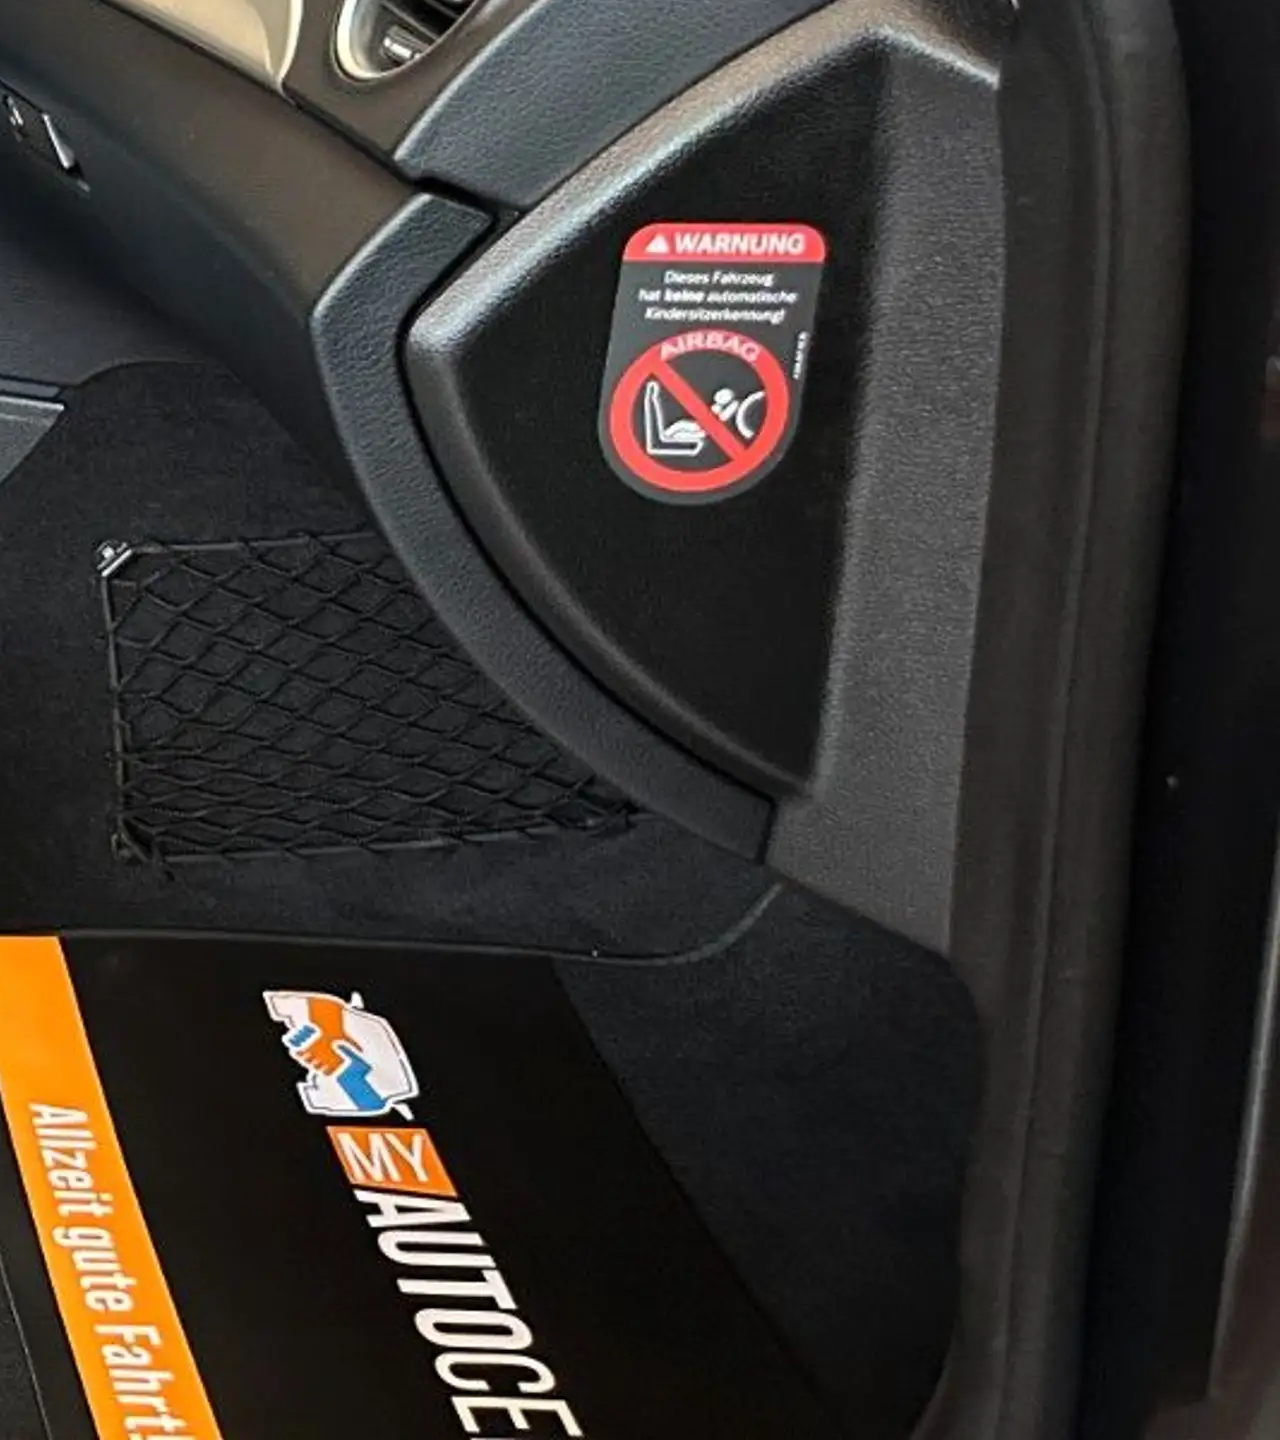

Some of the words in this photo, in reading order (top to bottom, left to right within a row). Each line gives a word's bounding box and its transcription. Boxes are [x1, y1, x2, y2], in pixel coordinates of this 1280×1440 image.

[674, 232, 807, 256] WARNUNG
[663, 270, 710, 285] Dieses
[712, 270, 774, 288] Fahrzeug
[638, 288, 661, 302] hat
[664, 288, 705, 303] keine
[707, 289, 799, 304] automatische
[644, 306, 786, 326] Kindersitzerkennung!
[660, 331, 762, 363] AIRBAG
[28, 1102, 115, 1218] Allzeit
[336, 1131, 430, 1183] MY
[51, 1226, 137, 1312] gute
